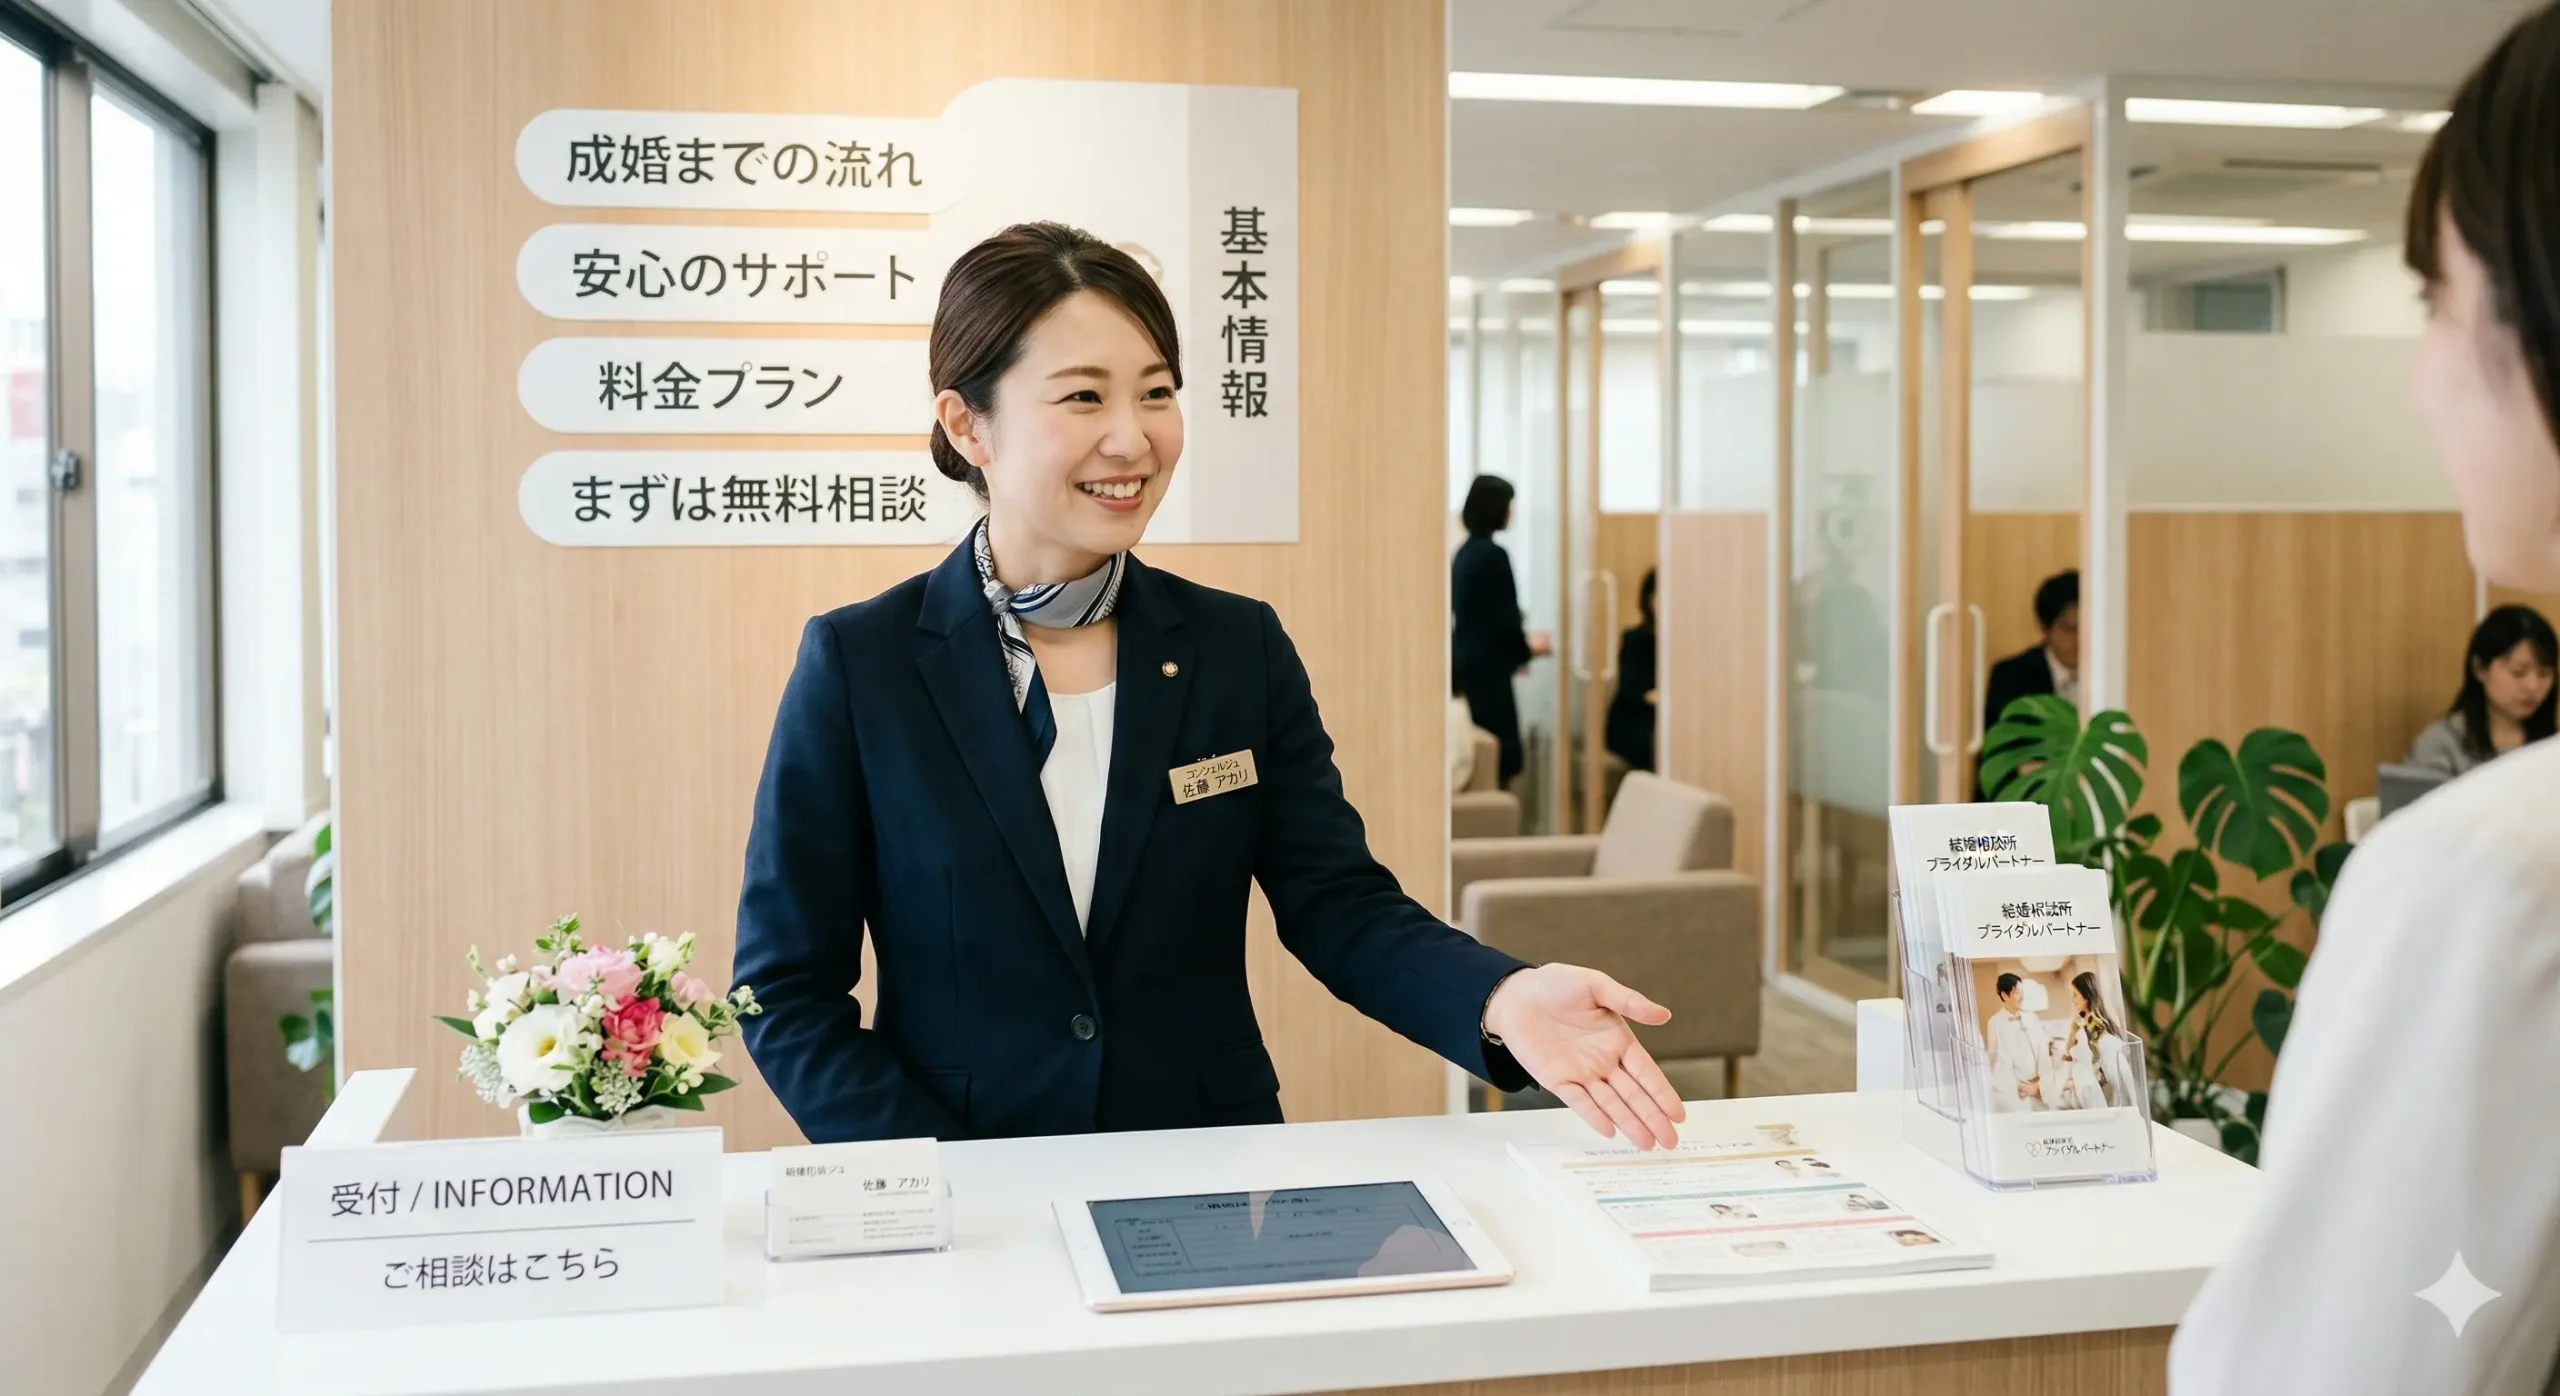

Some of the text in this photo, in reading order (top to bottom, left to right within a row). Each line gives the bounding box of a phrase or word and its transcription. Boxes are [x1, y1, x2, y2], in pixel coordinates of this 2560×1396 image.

[566, 132, 923, 188] 成婚までの流れ
[572, 247, 916, 300] 安心のサポート
[1220, 205, 1268, 418] 基本情報
[598, 360, 844, 412] 料金プラン
[571, 472, 927, 524] まずは無料相談
[1214, 768, 1248, 789] アカリ
[331, 1169, 673, 1217] 受付 / INFORMATION
[384, 1247, 619, 1290] ご相談はこちら
